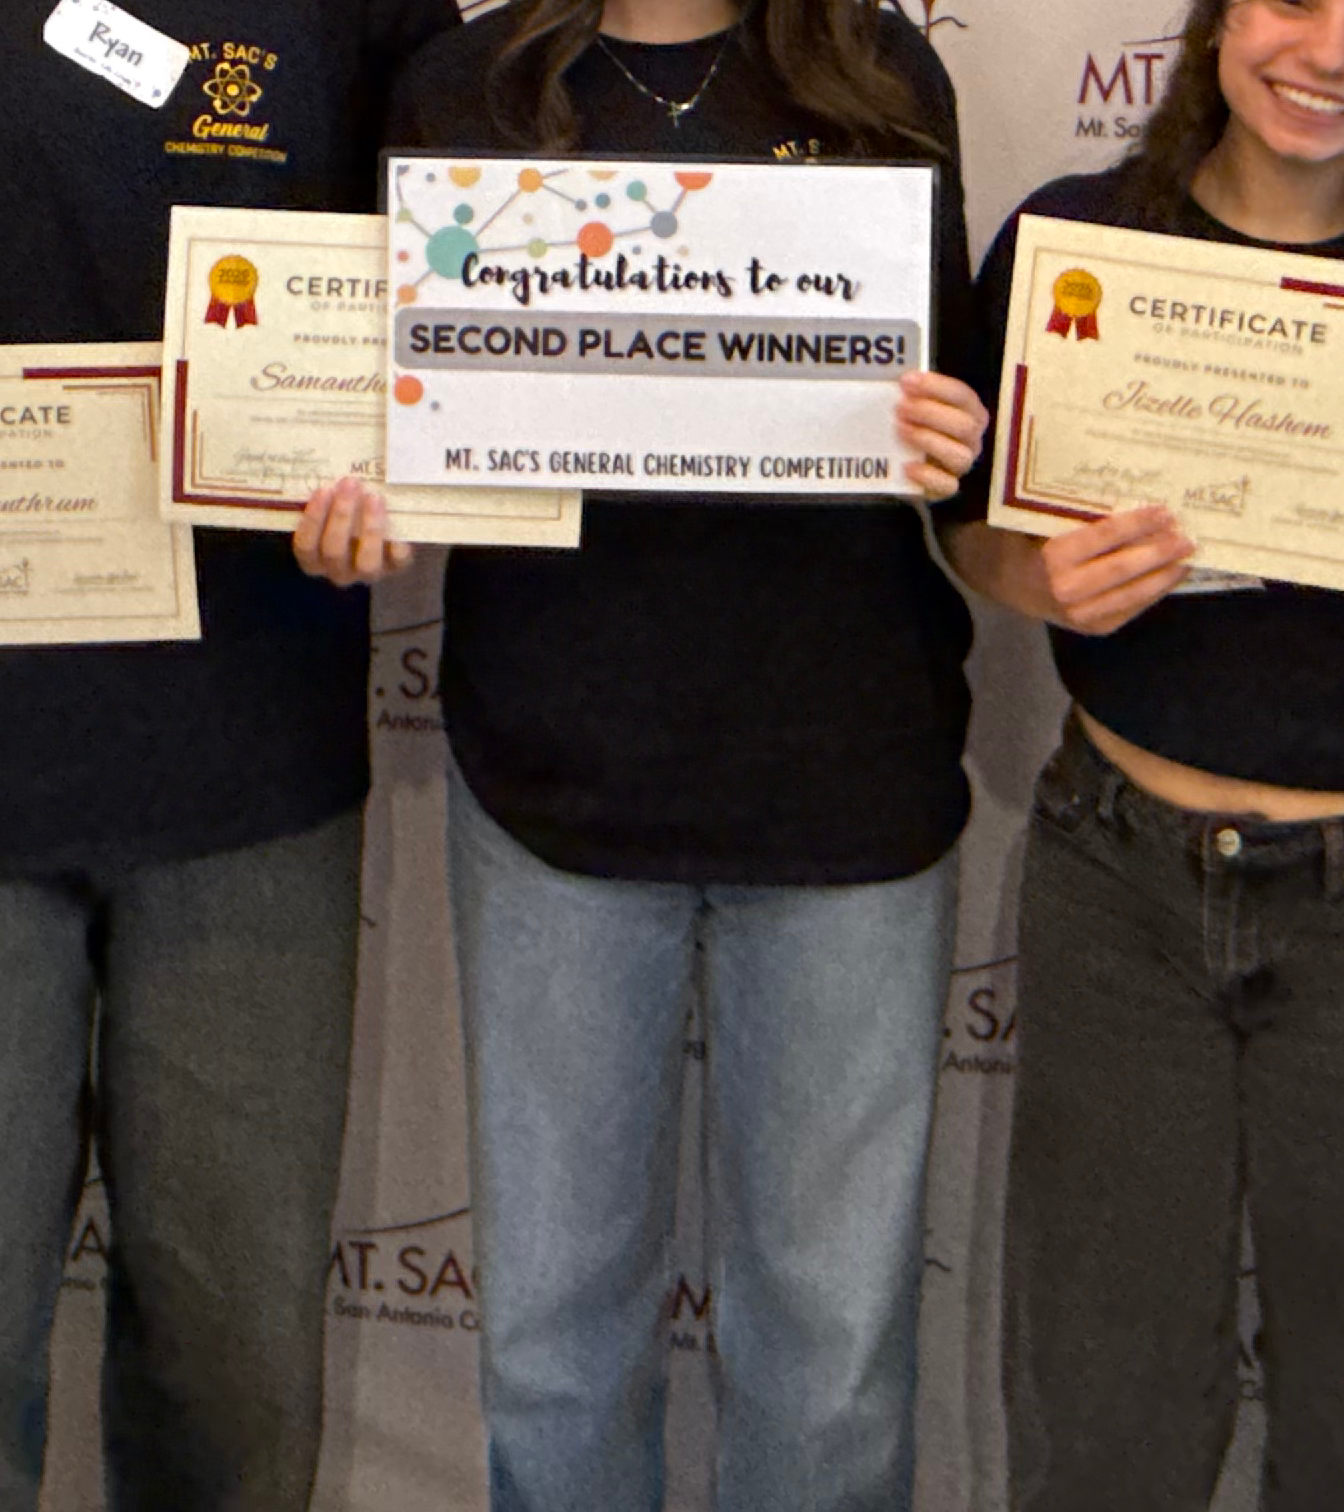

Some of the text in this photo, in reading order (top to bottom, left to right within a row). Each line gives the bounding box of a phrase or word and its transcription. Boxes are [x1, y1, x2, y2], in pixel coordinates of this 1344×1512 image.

[88, 21, 144, 67] Ryan
[222, 41, 278, 71] SAC'S
[1077, 52, 1165, 104] MT
[192, 114, 270, 142] General
[1075, 116, 1141, 138] Mt. Sa
[286, 275, 388, 298] CERTIF
[461, 252, 858, 307] Congratulations to our
[1129, 295, 1328, 344] CERTIFICATE
[293, 333, 356, 345] PROUDLY
[409, 324, 907, 365] SECOND PLACE WINNERS!
[1133, 352, 1199, 371] PROUDLY
[1204, 362, 1286, 386] PRESENTED
[445, 448, 480, 471] MT.
[488, 449, 541, 473] SAC'S
[550, 452, 635, 476] GENERAL
[397, 1245, 474, 1300] SA
[333, 1295, 371, 1319] San
[376, 1302, 455, 1330] Antonio
